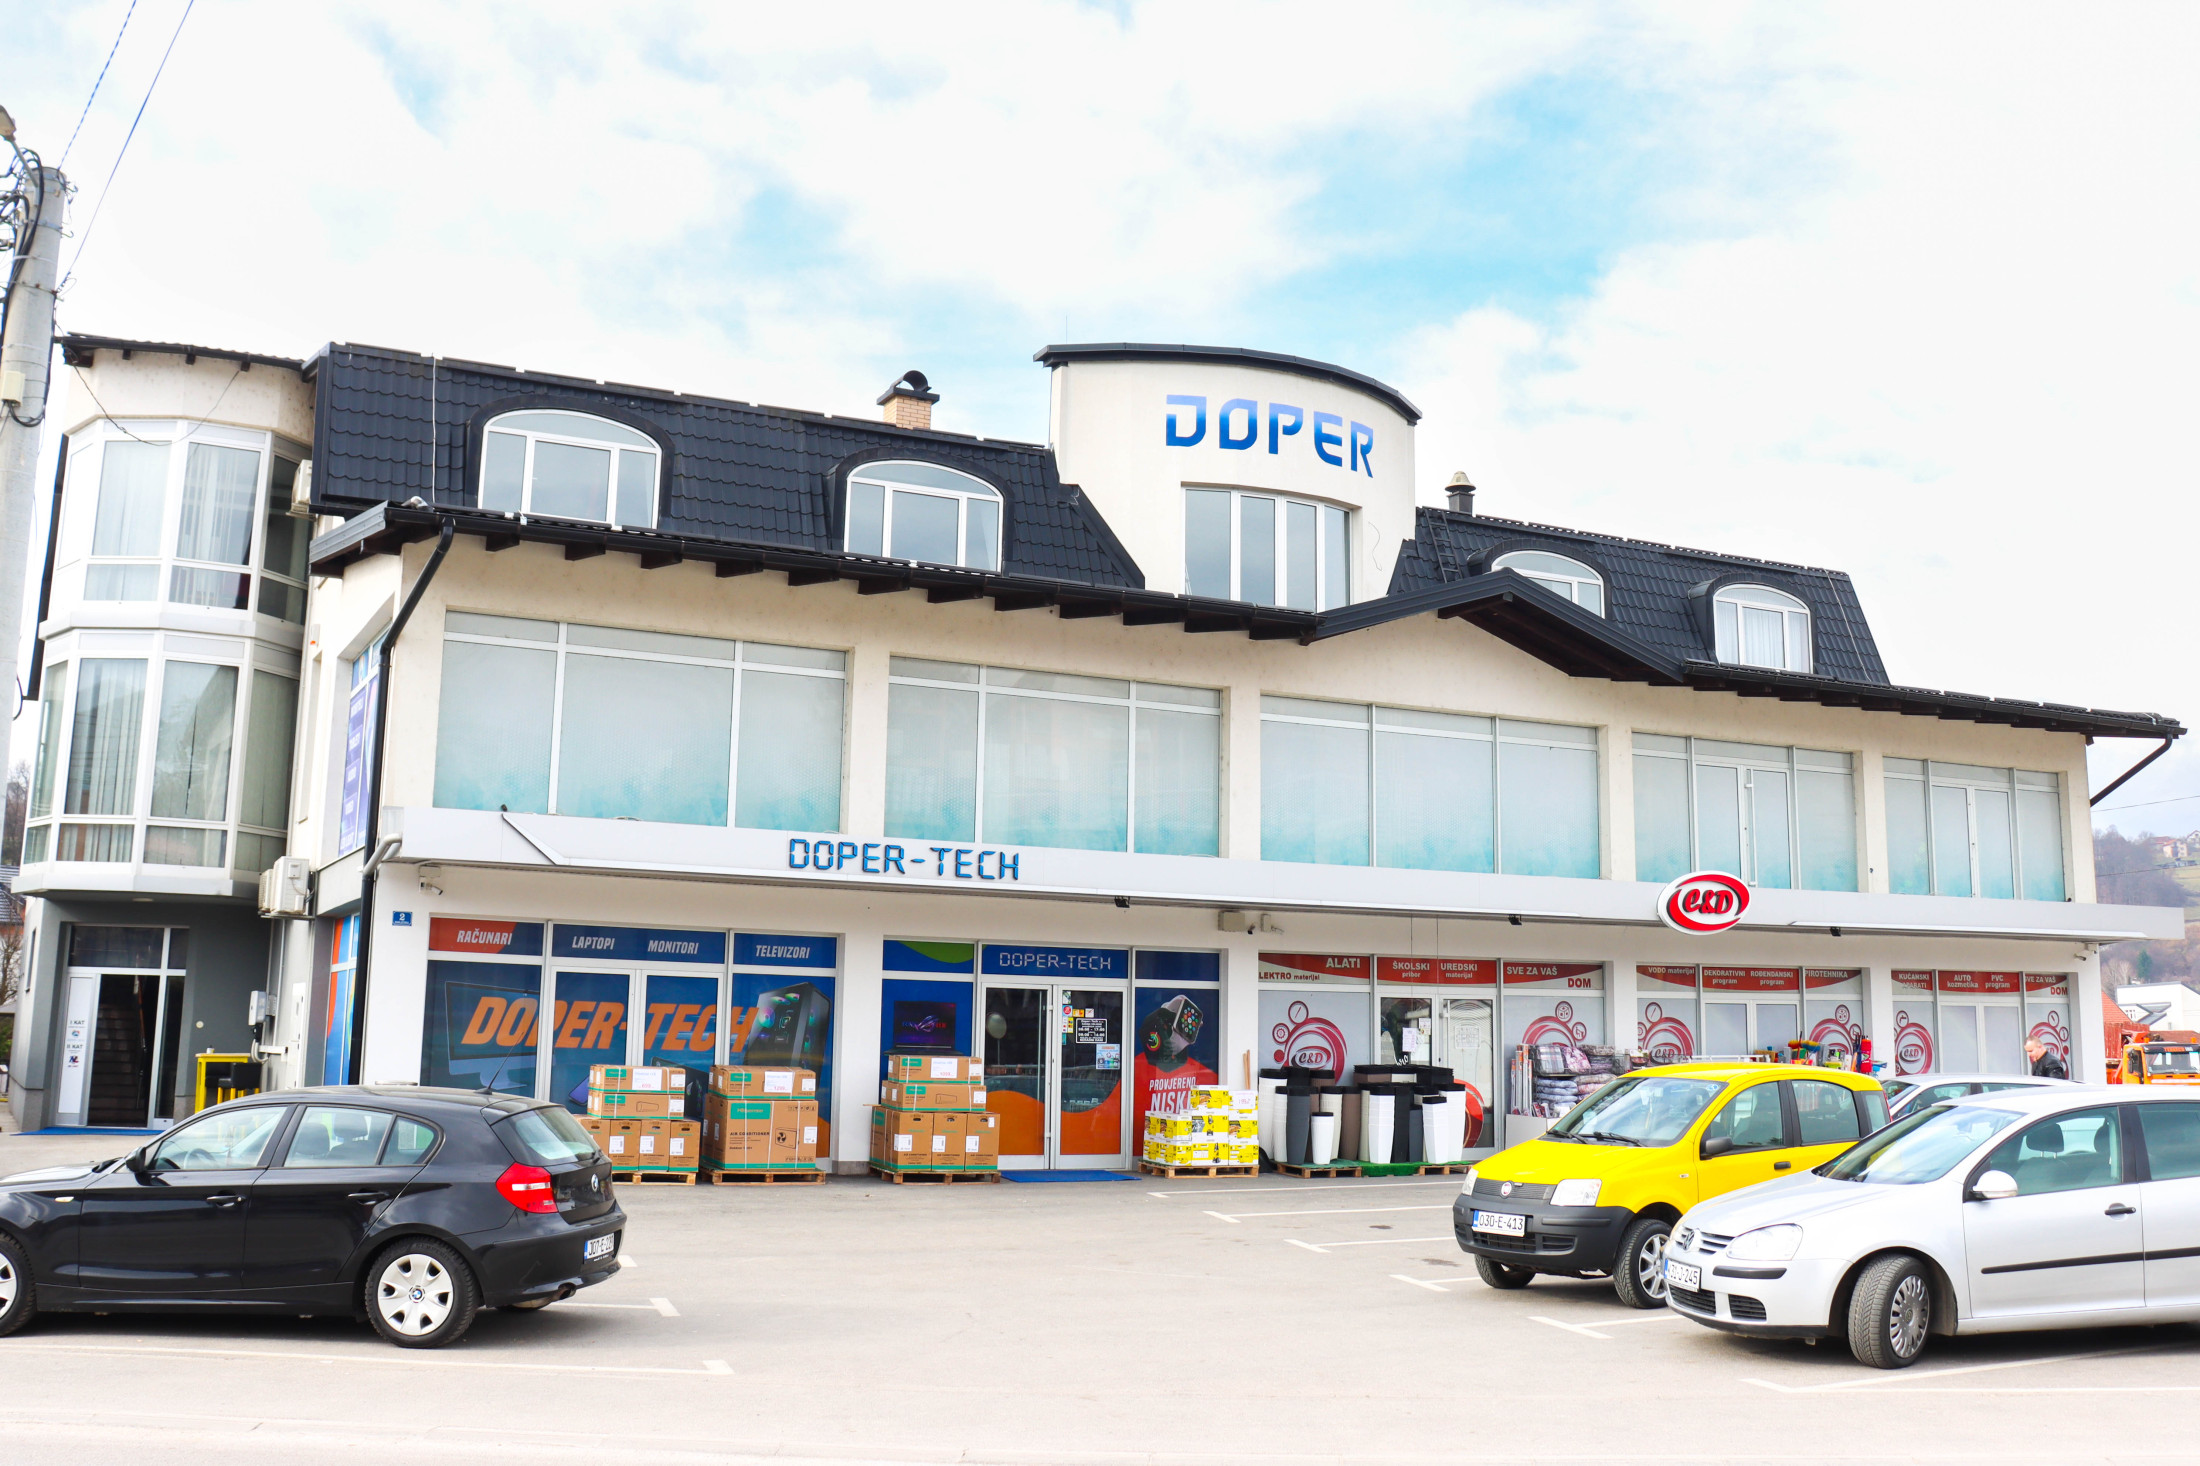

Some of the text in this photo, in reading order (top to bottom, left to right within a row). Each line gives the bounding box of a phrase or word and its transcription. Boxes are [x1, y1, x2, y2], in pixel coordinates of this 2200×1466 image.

[1165, 394, 1374, 478] DOPER
[789, 838, 1019, 880] DOPER-TECH
[399, 913, 406, 921] 2
[456, 928, 513, 945] RAČUNARI
[571, 936, 616, 950] LAPTOPI
[647, 939, 699, 954] MONITORI
[755, 944, 810, 959] TELEVIZORI
[999, 952, 1111, 970] DOPER-TECH
[1325, 957, 1361, 968] ALATI
[1392, 961, 1430, 971] ŠKOLSKI
[1440, 962, 1478, 971] UREDSKI
[1506, 965, 1558, 976] SVE ZA VAŠ
[1648, 966, 1695, 975] VODO materijal
[1258, 971, 1292, 980] LEKTRO
[1402, 971, 1421, 979] pribor
[1445, 971, 1473, 980] materijal
[1703, 969, 1746, 977] DEKORATIVNI
[1805, 970, 1848, 978] PIROTEHNIKA
[1567, 977, 1591, 988] DOM
[1712, 977, 1738, 985] program
[1759, 978, 1785, 986] program
[1953, 974, 1972, 982] AUTO
[1991, 974, 2004, 982] PVC
[2044, 975, 2056, 983] VAŠ
[1947, 981, 1979, 989] kozmetika
[1985, 982, 2011, 990] program
[2050, 986, 2068, 996] DOM
[1299, 1052, 1324, 1063] C&D
[1149, 1076, 1196, 1091] PROVJERENO
